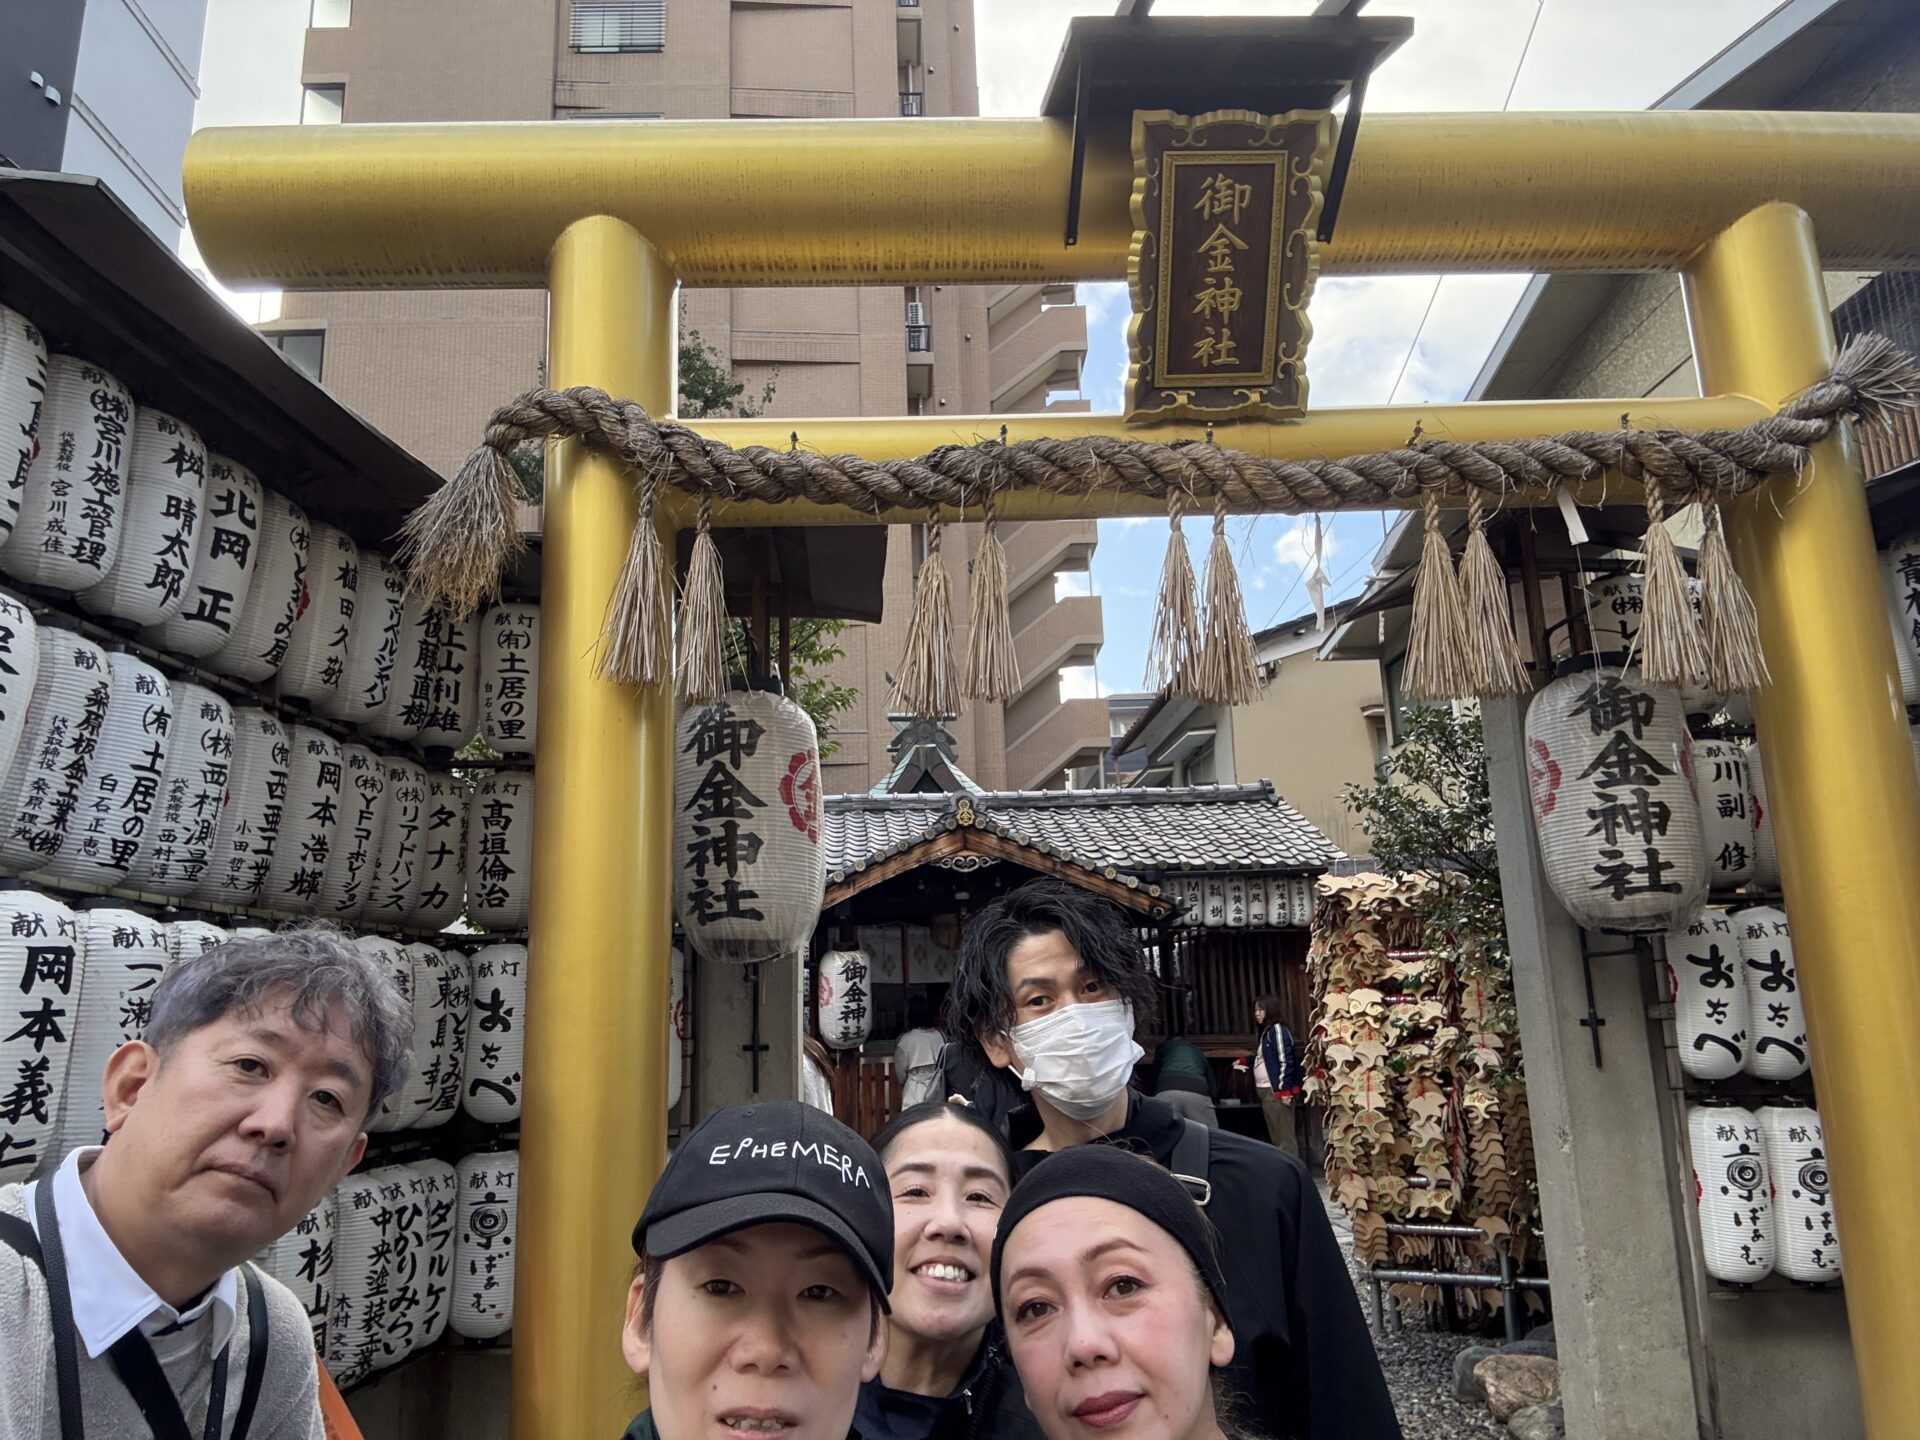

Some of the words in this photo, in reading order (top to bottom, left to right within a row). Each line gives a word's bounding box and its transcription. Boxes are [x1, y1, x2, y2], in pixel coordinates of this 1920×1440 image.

[1192, 173, 1252, 367] 御金神社
[283, 761, 342, 901] 岡本浩輝
[682, 701, 768, 927] 御金神社
[1568, 676, 1683, 901] 御金神社
[419, 803, 457, 910] タナカ
[10, 911, 77, 943] 献灯
[112, 926, 168, 952] 献灯
[478, 960, 520, 978] 献灯
[837, 959, 869, 1042] 御金神社
[0, 945, 76, 1168] 岡本義仁
[470, 1171, 515, 1189] 献灯
[709, 1137, 871, 1189] EPHEMERA
[1715, 1125, 1760, 1143] 献灯
[383, 1203, 424, 1355] ひかりみらい
